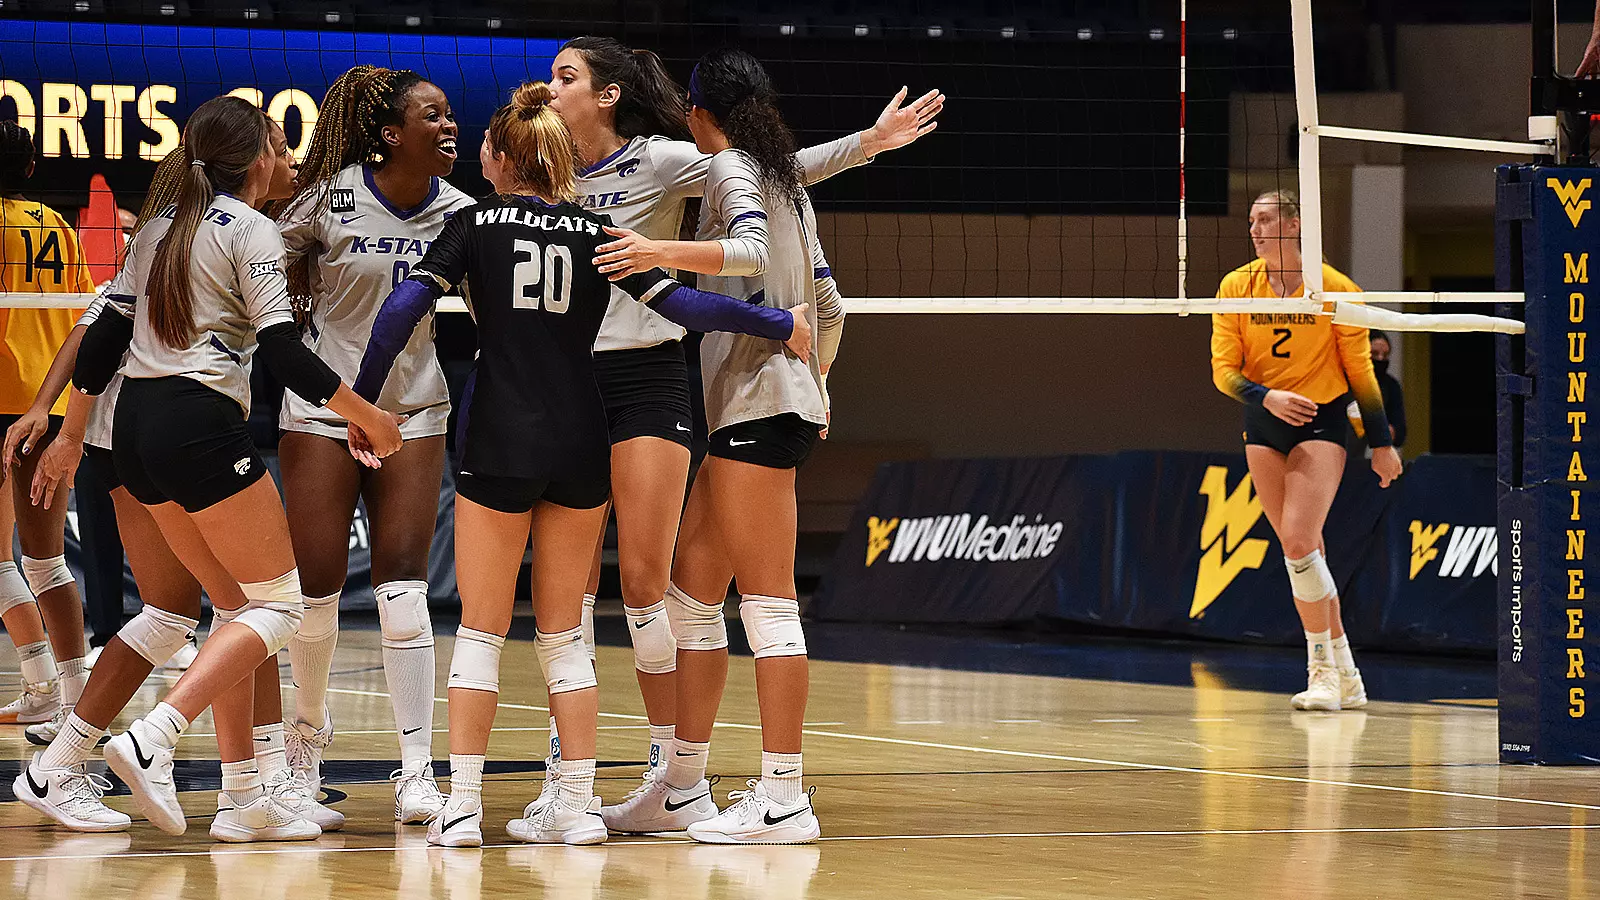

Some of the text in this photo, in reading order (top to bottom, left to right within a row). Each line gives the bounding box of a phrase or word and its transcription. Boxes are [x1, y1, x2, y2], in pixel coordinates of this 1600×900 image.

[332, 193, 354, 208] BLM
[475, 207, 600, 236] WILDCATS
[20, 229, 64, 284] 14
[512, 238, 573, 315] 20
[1271, 328, 1292, 358] 2
[1563, 252, 1589, 719] MOUNTAINEERS
[1438, 525, 1498, 577] WV
[1510, 519, 1523, 582] sports
